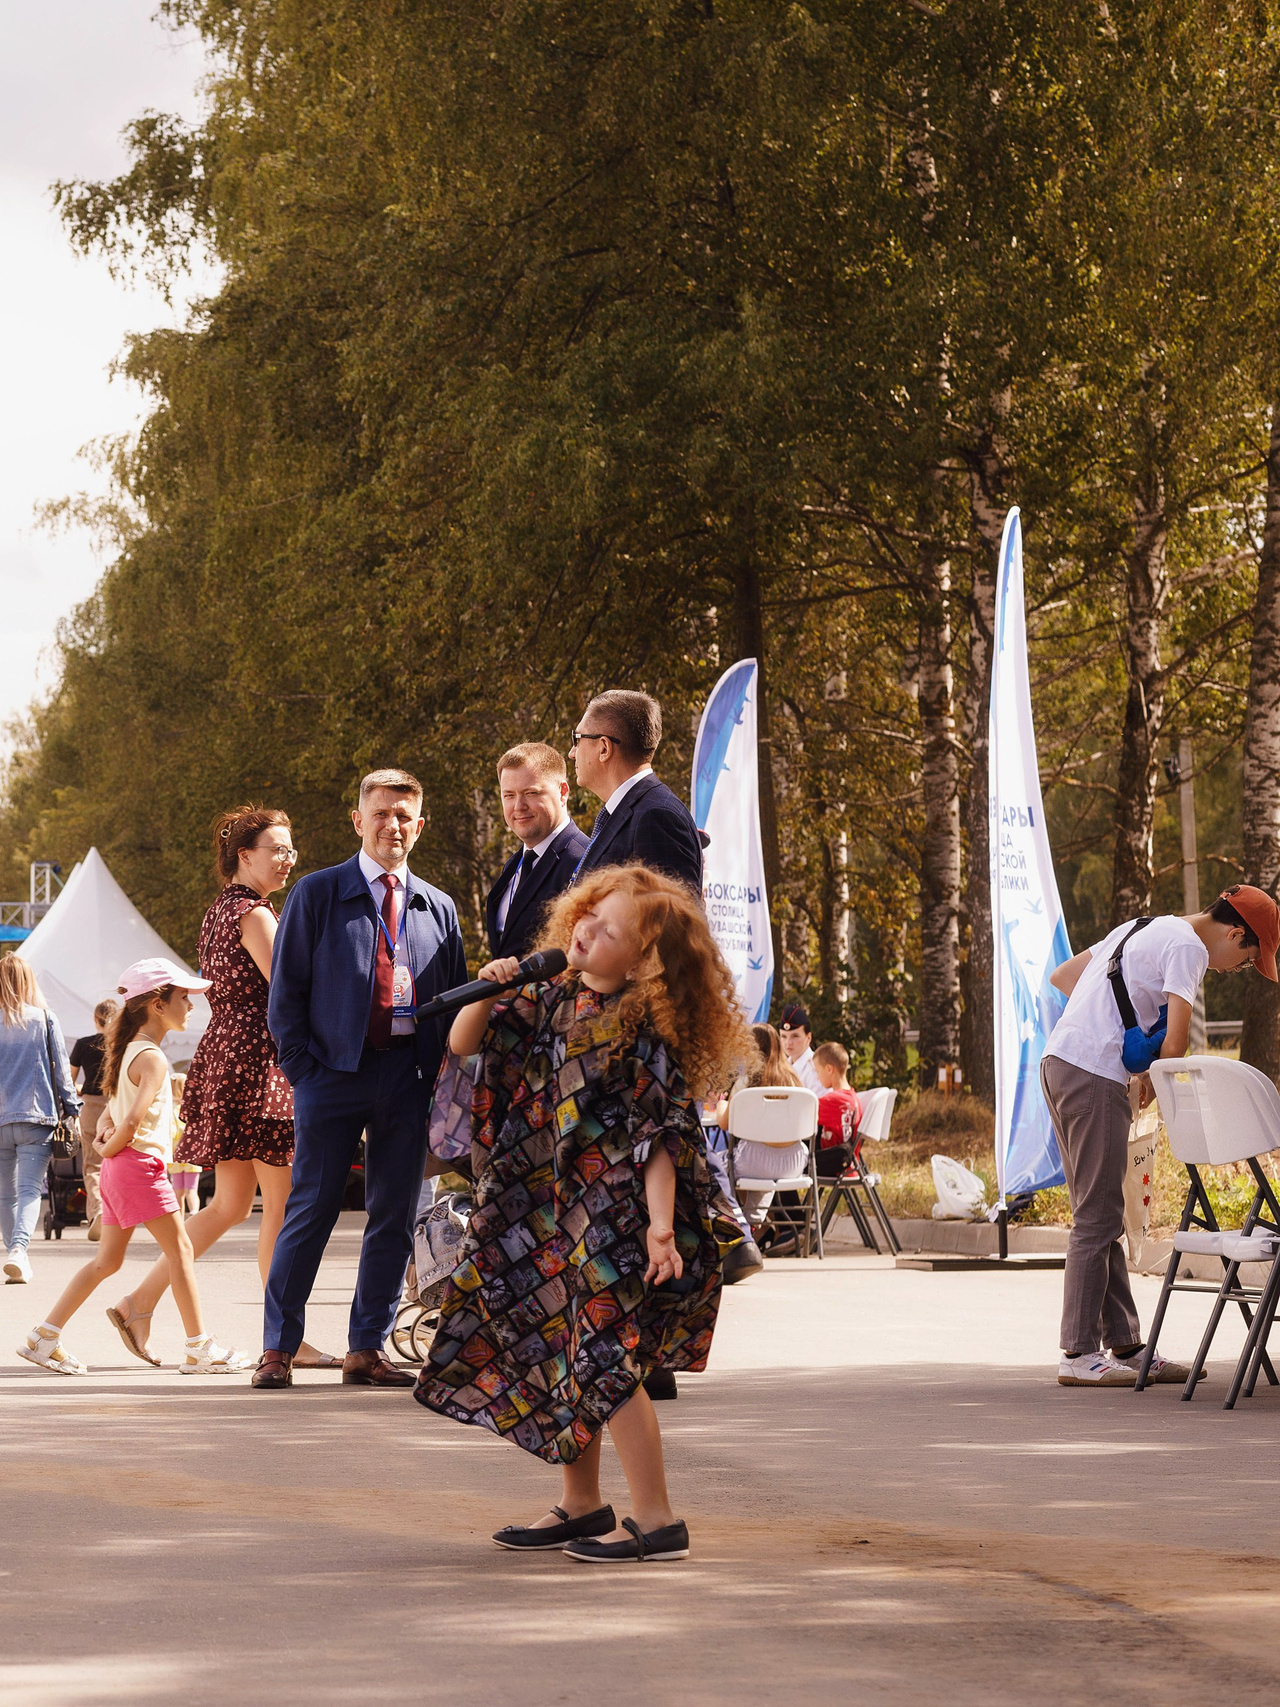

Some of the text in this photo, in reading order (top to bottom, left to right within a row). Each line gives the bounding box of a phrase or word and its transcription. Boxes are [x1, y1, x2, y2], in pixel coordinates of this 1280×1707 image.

[1000, 805, 1035, 828] АРЫ
[708, 882, 761, 903] БОКСАРЫ
[711, 904, 745, 918] СТОЛИЦА
[709, 920, 753, 936] УВАШСКОЙ
